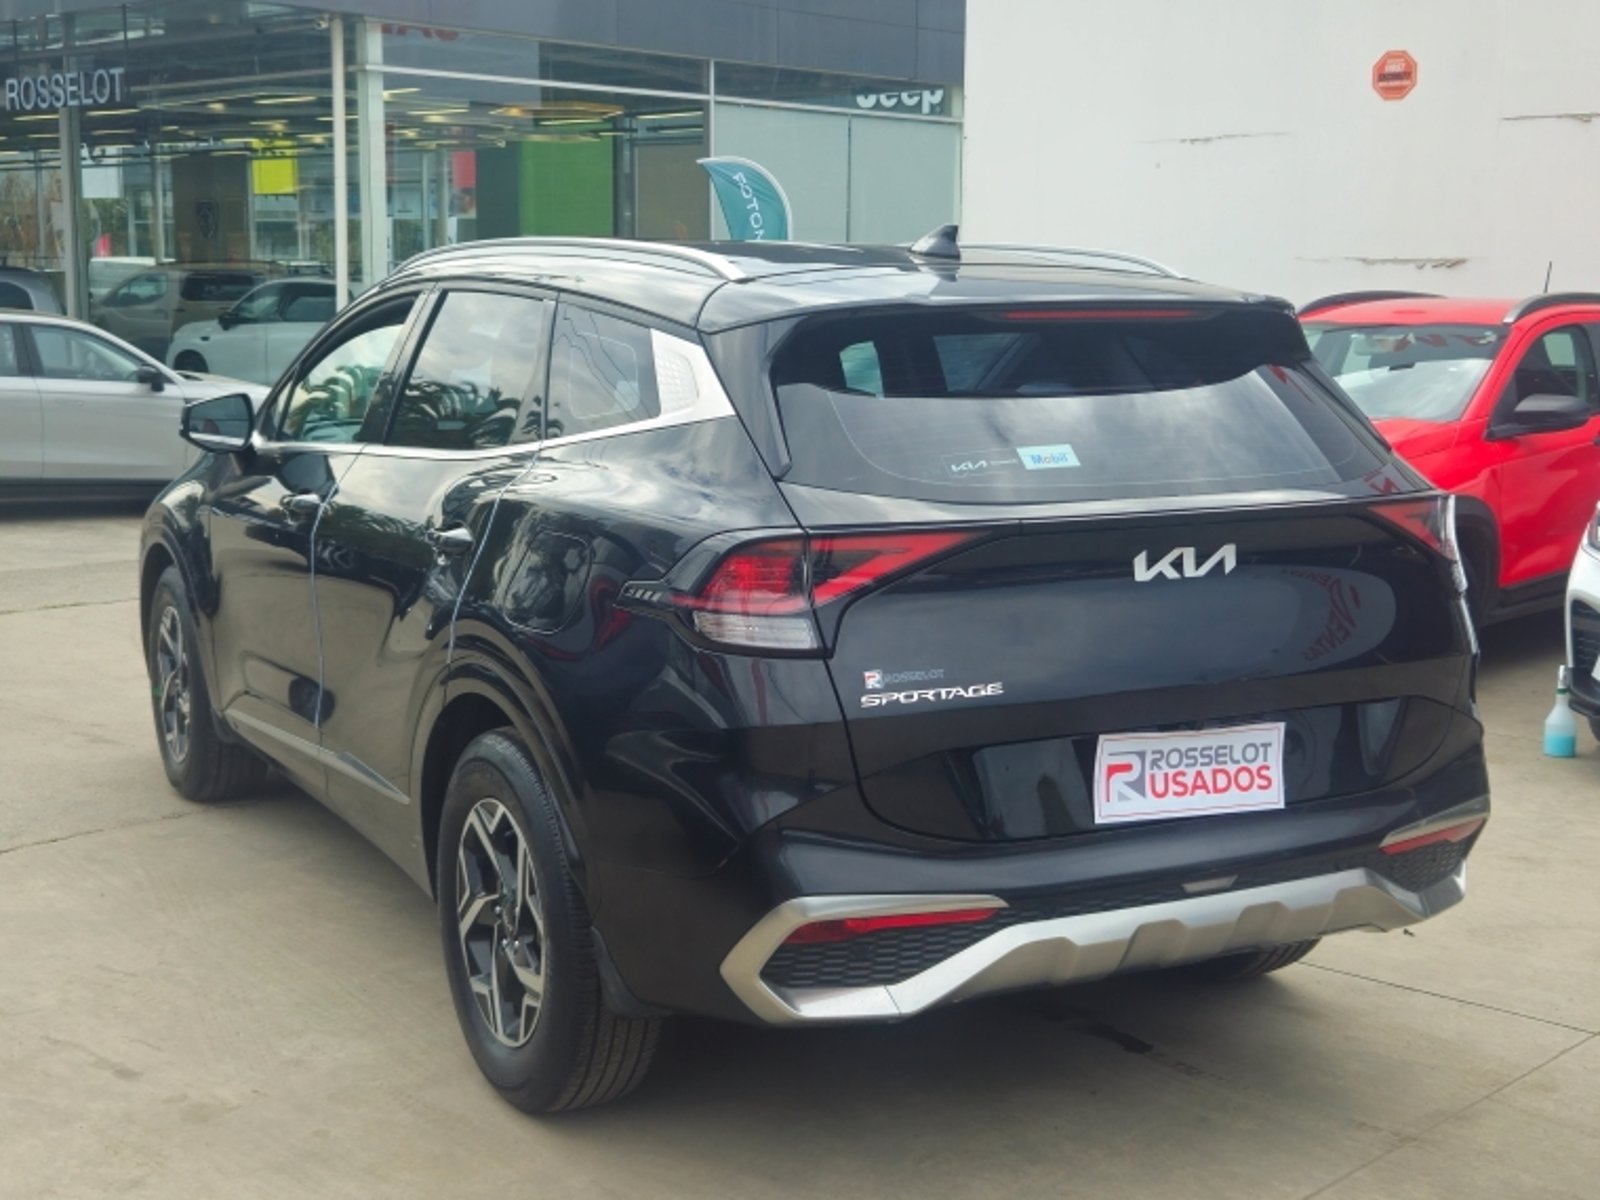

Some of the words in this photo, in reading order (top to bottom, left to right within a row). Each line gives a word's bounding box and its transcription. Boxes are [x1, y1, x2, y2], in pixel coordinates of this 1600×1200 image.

[5, 67, 125, 111] ROSSELOT
[1133, 543, 1237, 582] KIA
[860, 681, 1006, 709] SPORTAGE
[1150, 742, 1273, 770] ROSSELOT
[1150, 765, 1273, 799] USADOS
